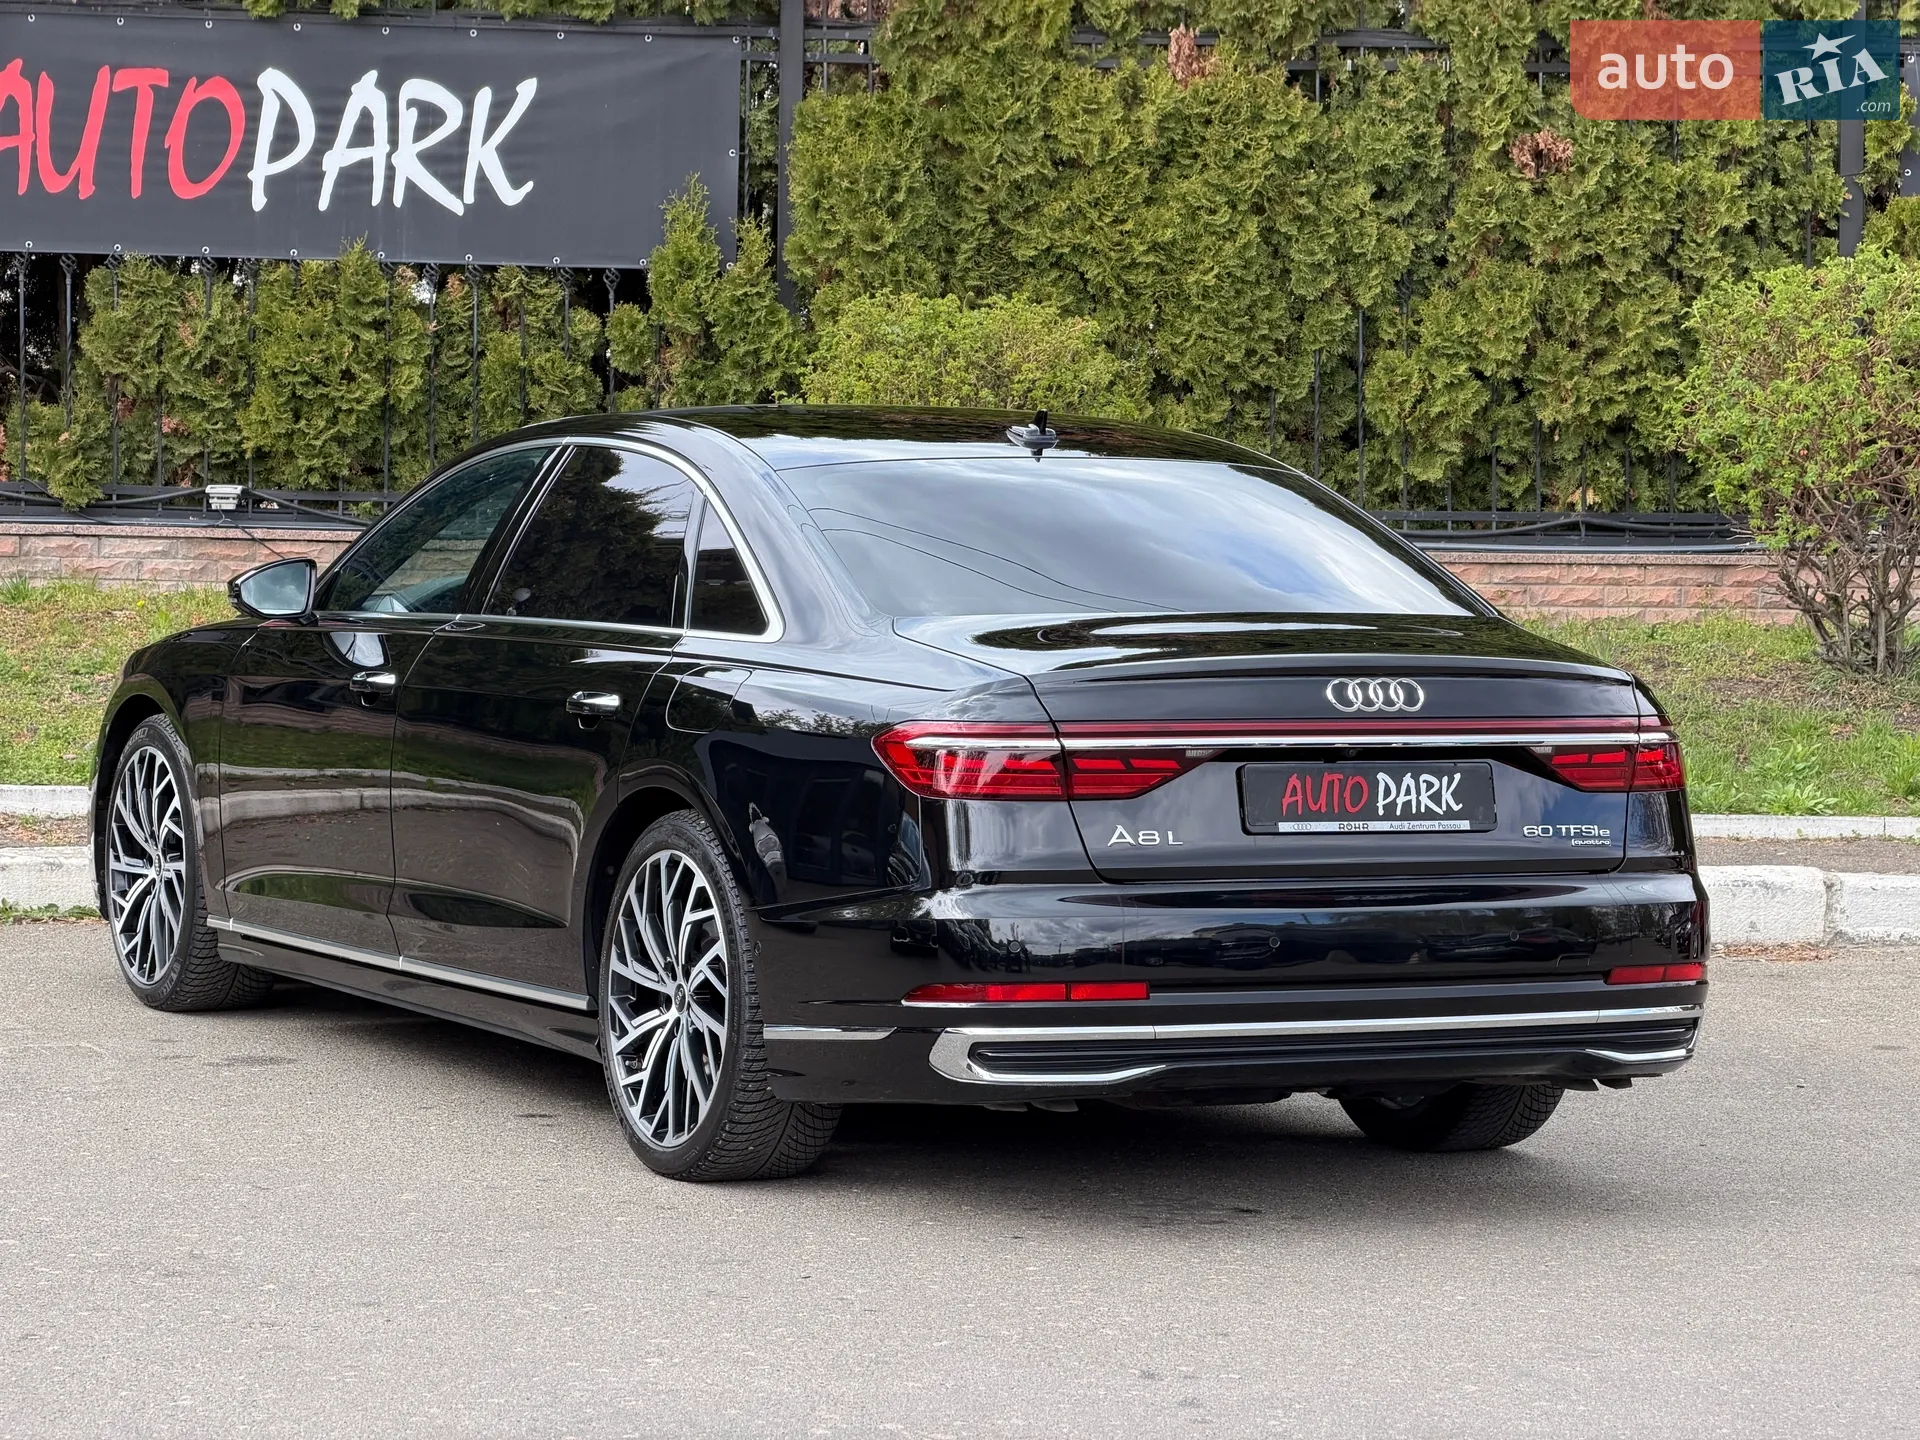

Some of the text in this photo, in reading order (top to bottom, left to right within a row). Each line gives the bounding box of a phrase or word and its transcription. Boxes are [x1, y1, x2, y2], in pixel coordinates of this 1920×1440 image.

[1281, 772, 1463, 816] AUTO PARK
[1389, 822, 1406, 830] Audi
[1406, 822, 1437, 830] Zentrum
[1523, 825, 1553, 837] 60
[1574, 839, 1610, 847] quattro
